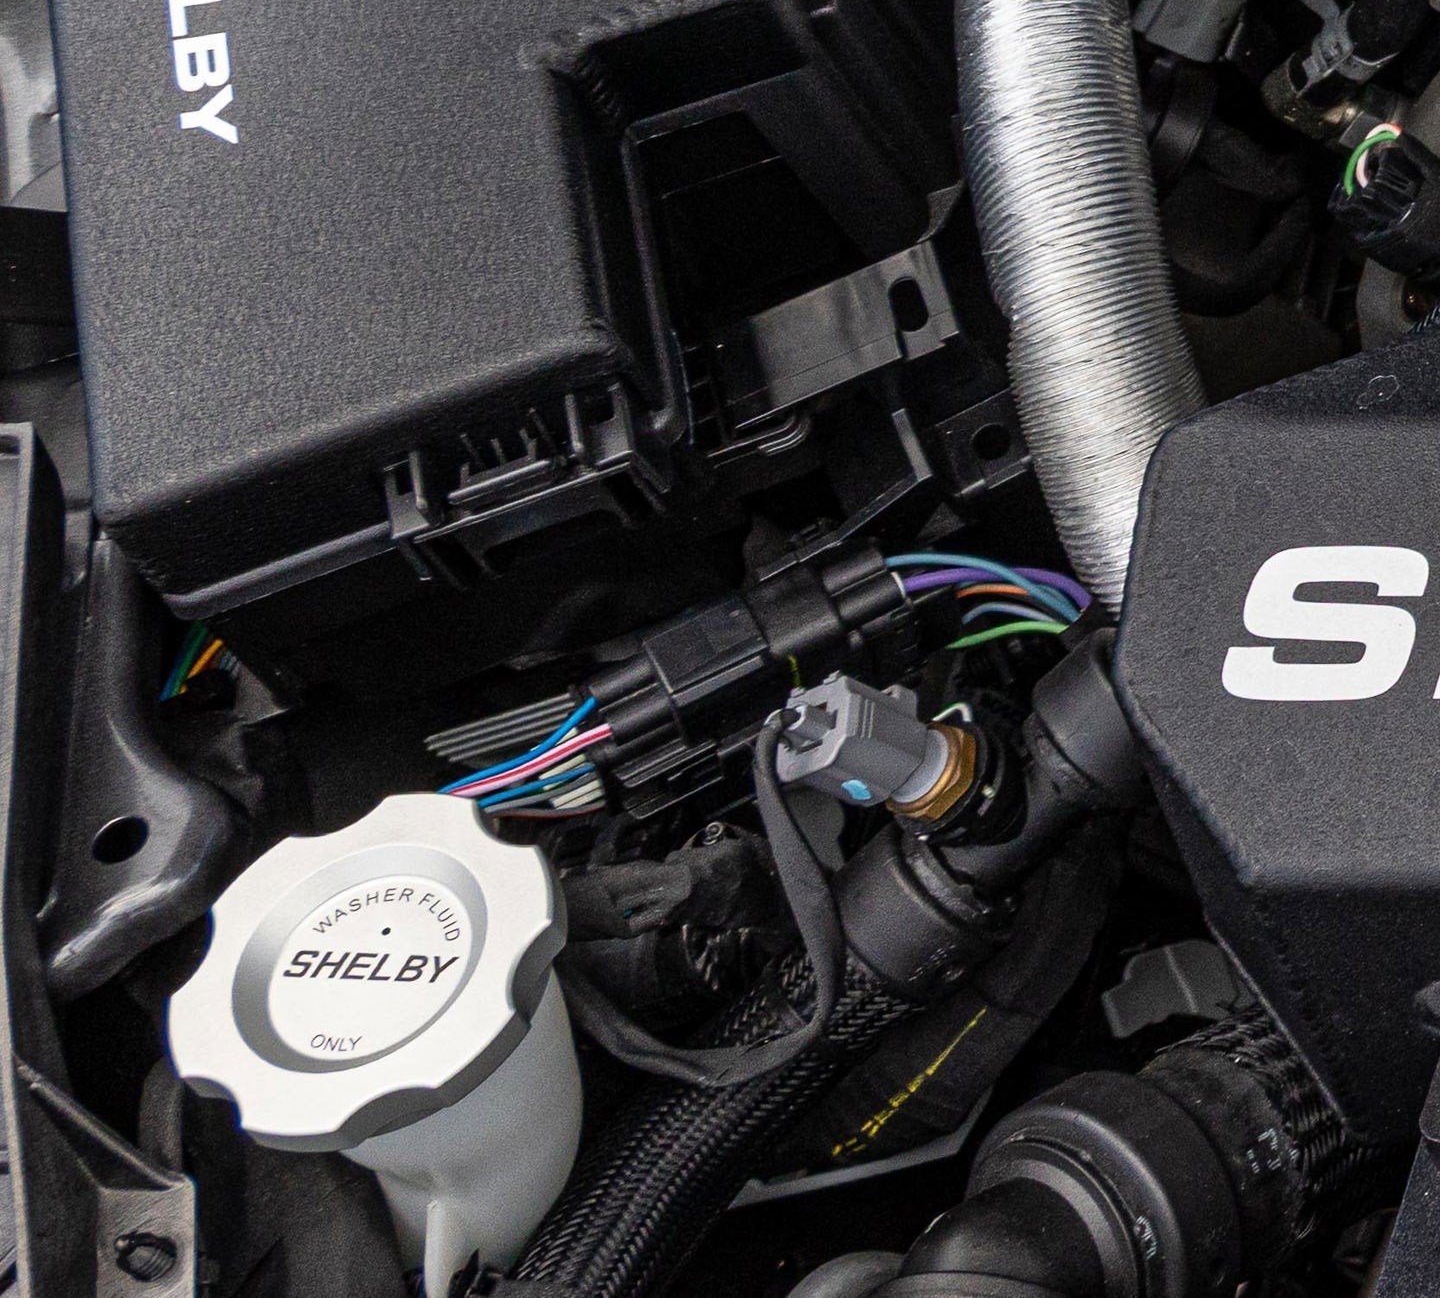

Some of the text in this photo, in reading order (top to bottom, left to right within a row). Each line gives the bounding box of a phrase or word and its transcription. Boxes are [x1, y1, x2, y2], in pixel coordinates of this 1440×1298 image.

[312, 886, 462, 943] WASHER FLUID
[283, 950, 461, 986] SHELBY
[310, 1032, 363, 1054] ONLY
